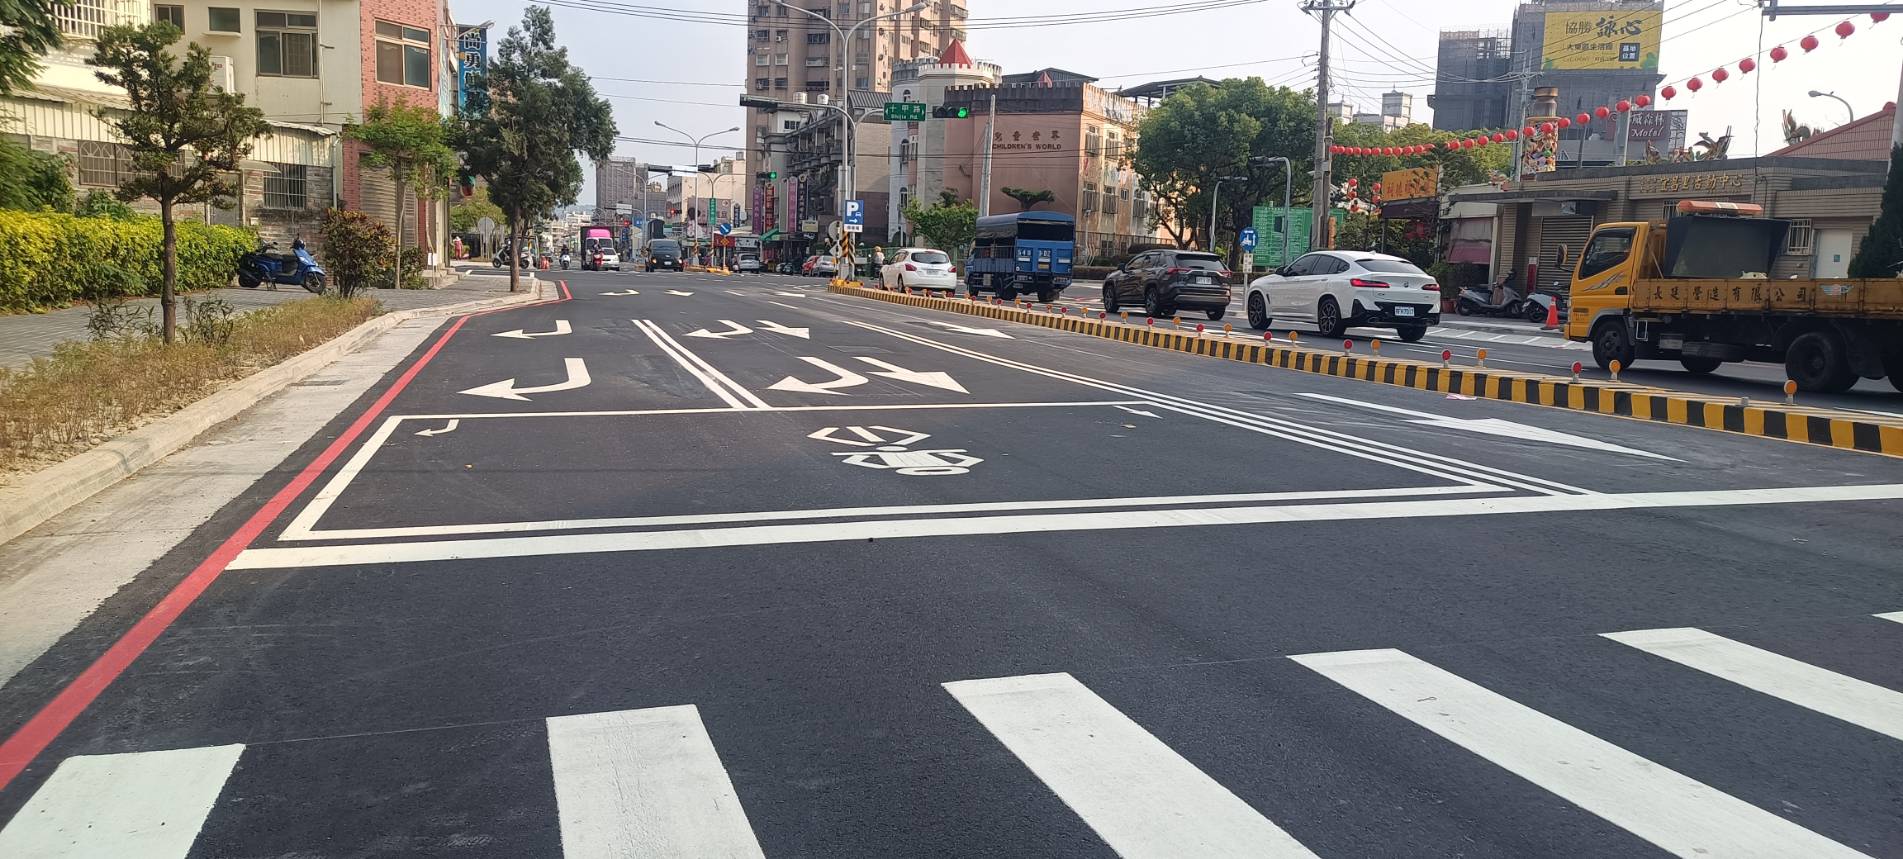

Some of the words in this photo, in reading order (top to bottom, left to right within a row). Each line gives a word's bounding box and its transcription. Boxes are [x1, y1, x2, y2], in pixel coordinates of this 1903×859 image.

[994, 130, 1061, 142] 兒童世界
[1631, 126, 1664, 137] Motel
[846, 201, 859, 216] P
